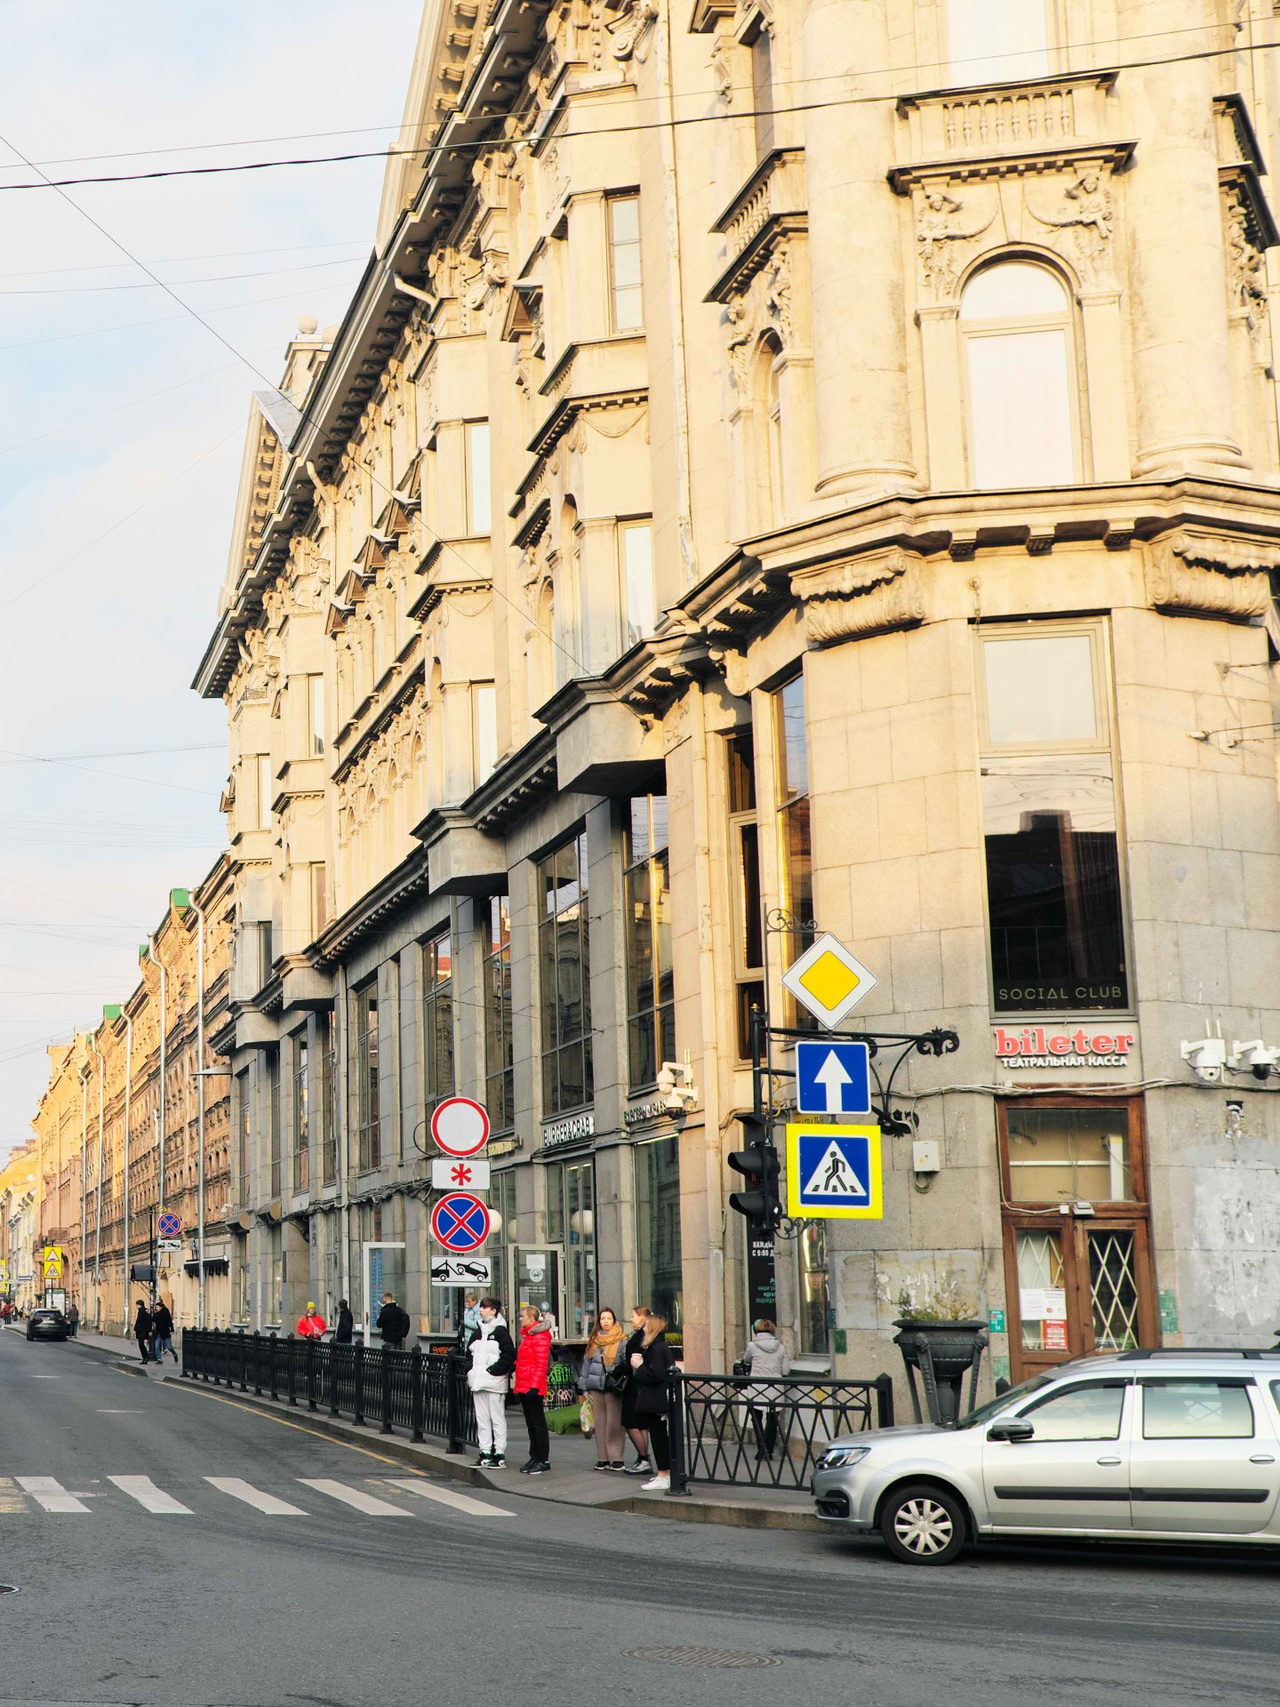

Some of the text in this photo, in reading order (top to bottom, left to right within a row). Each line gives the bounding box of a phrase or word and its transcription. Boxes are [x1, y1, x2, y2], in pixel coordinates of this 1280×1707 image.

[999, 986, 1122, 1000] SOCIAL CLUB
[994, 1027, 1134, 1056] bileter
[1001, 1056, 1128, 1068] ТЕАТРАЛЬНАЯ КАССА
[752, 1241, 774, 1249] КАЖДЫ
